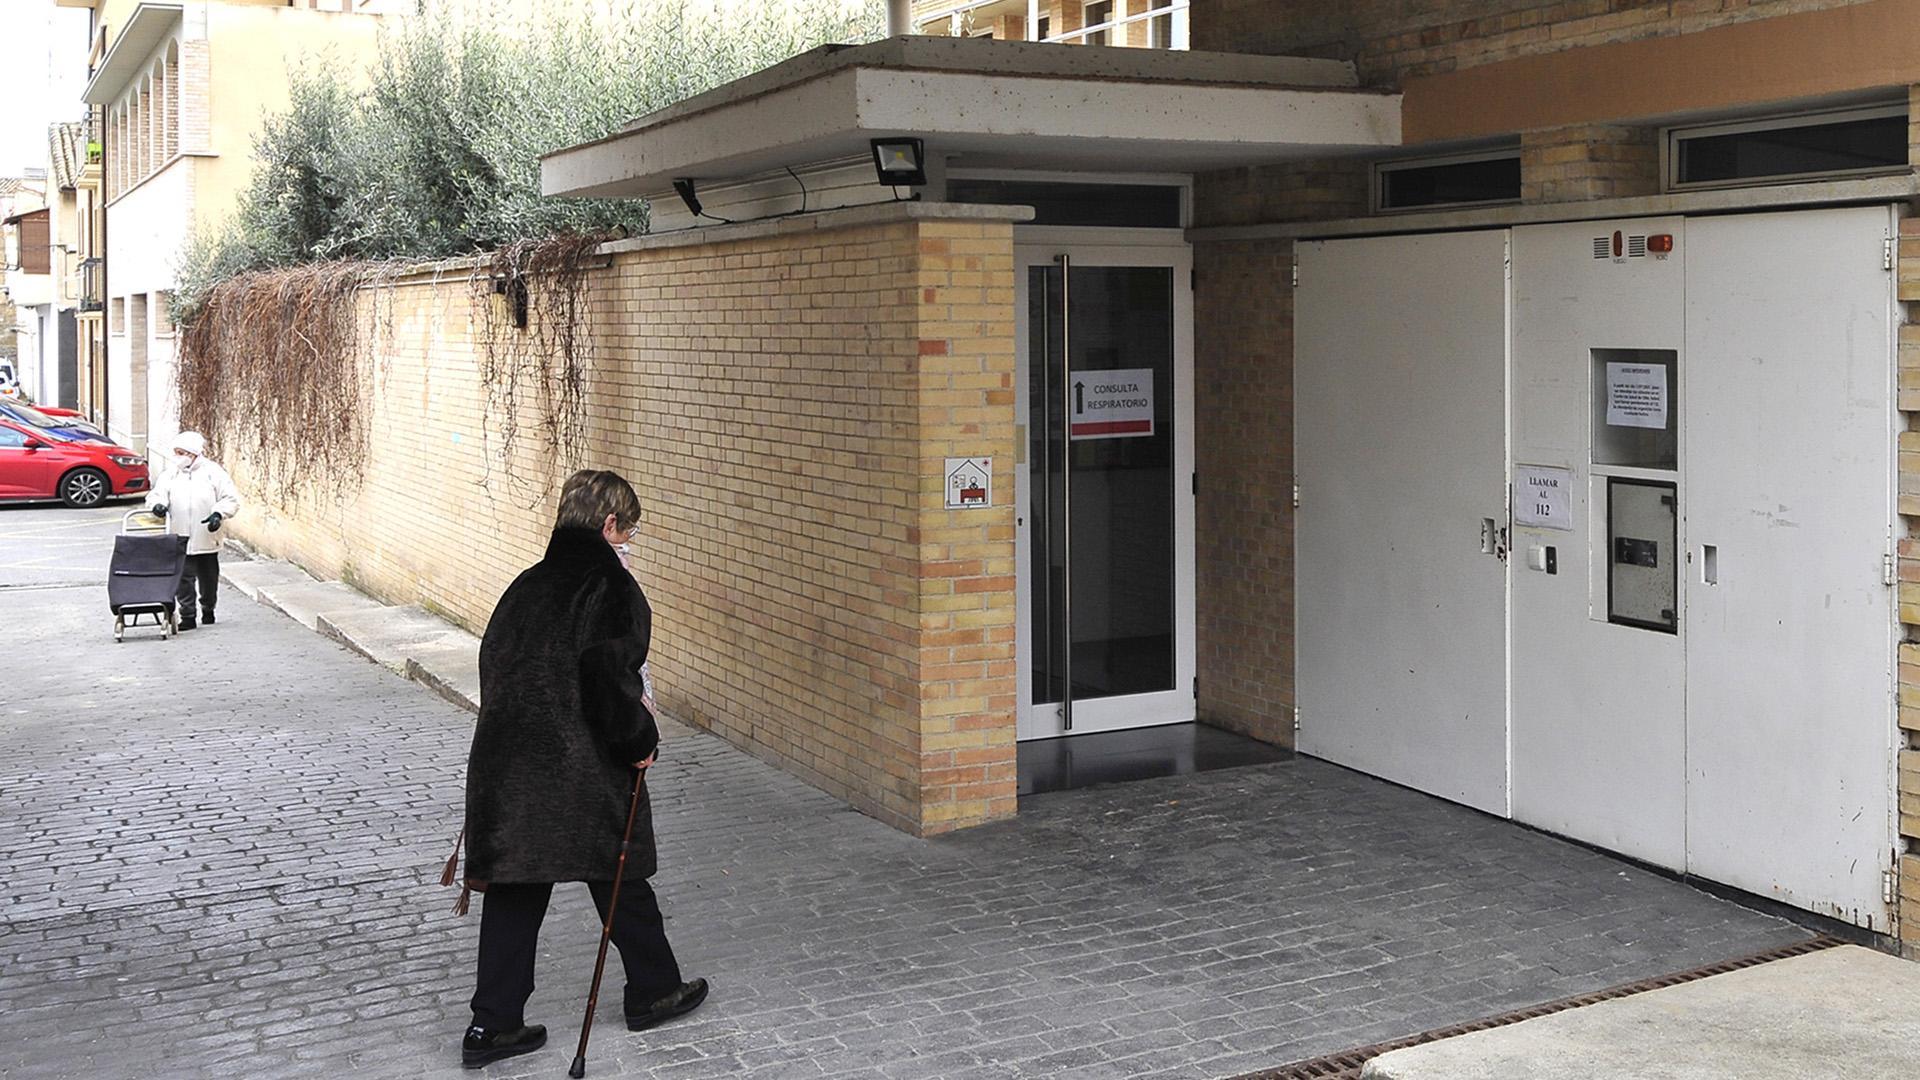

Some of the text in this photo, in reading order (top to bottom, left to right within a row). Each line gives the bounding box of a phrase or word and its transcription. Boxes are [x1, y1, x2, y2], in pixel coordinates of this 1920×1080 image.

[1094, 384, 1139, 394] CONSULTA
[1087, 399, 1148, 409] RESPIRATORIO
[1529, 477, 1559, 488] LLAMAR
[1539, 490, 1549, 499] AL
[1535, 503, 1551, 516] 112
